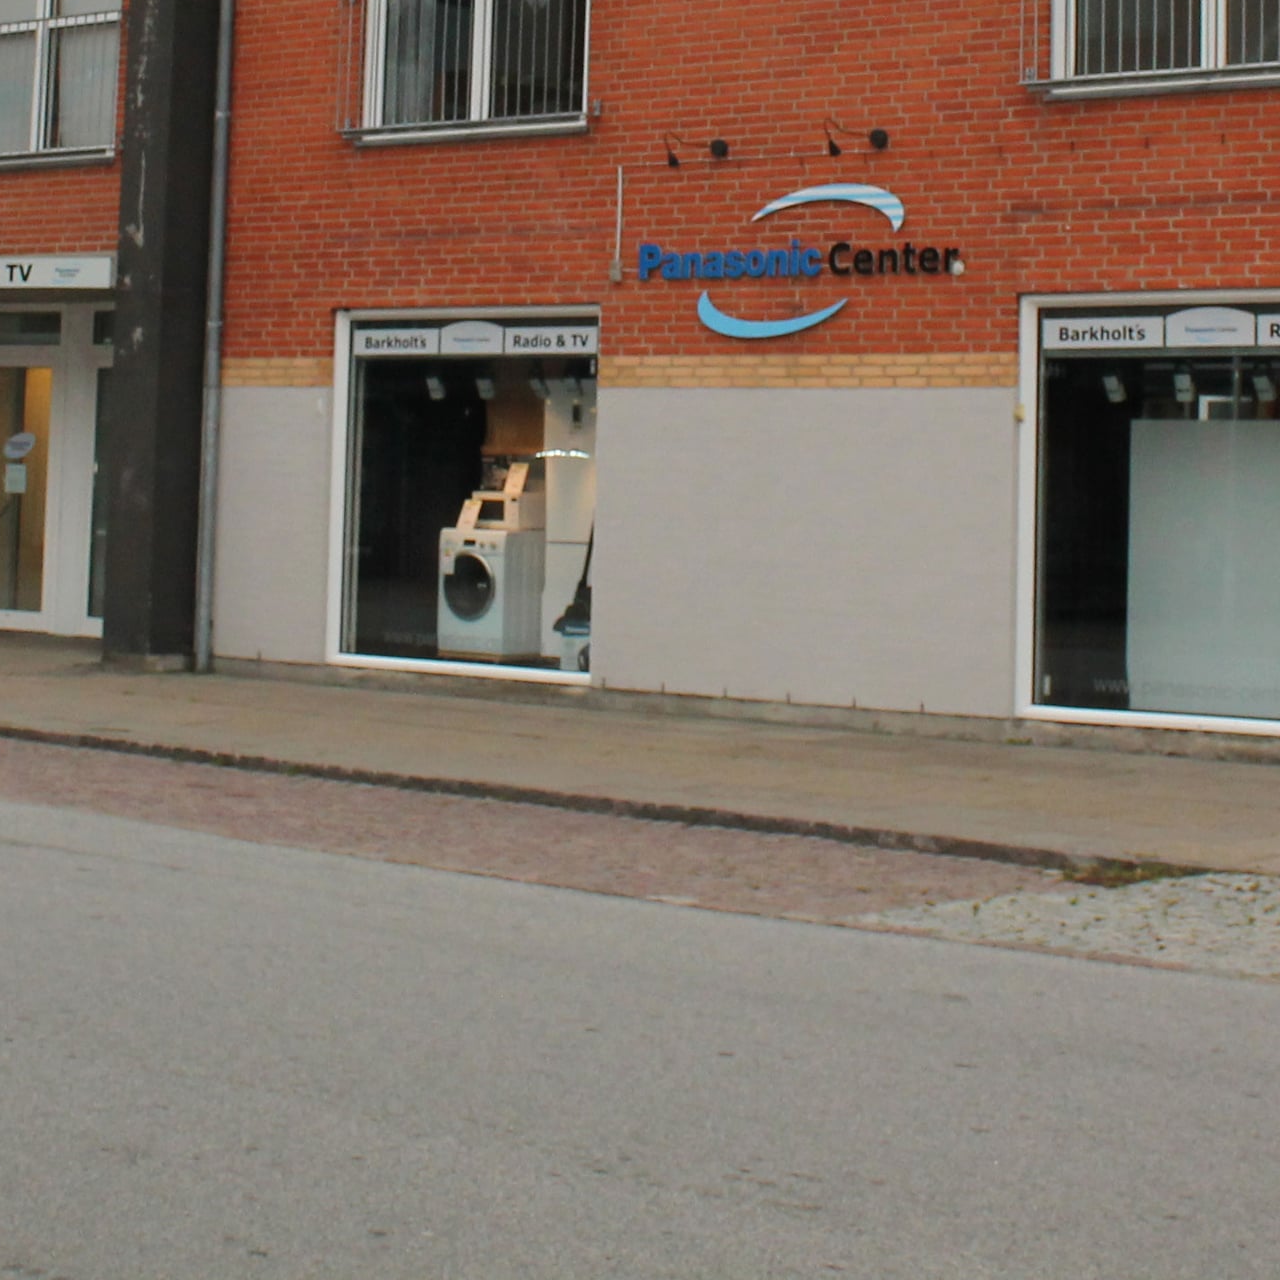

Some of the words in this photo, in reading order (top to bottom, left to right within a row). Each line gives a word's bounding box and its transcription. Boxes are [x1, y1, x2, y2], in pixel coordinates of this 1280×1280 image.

[637, 239, 822, 281] Panasonic
[828, 241, 961, 276] Center
[6, 264, 33, 282] TV
[513, 334, 552, 349] Radio
[556, 334, 566, 348] &
[572, 333, 589, 347] TV
